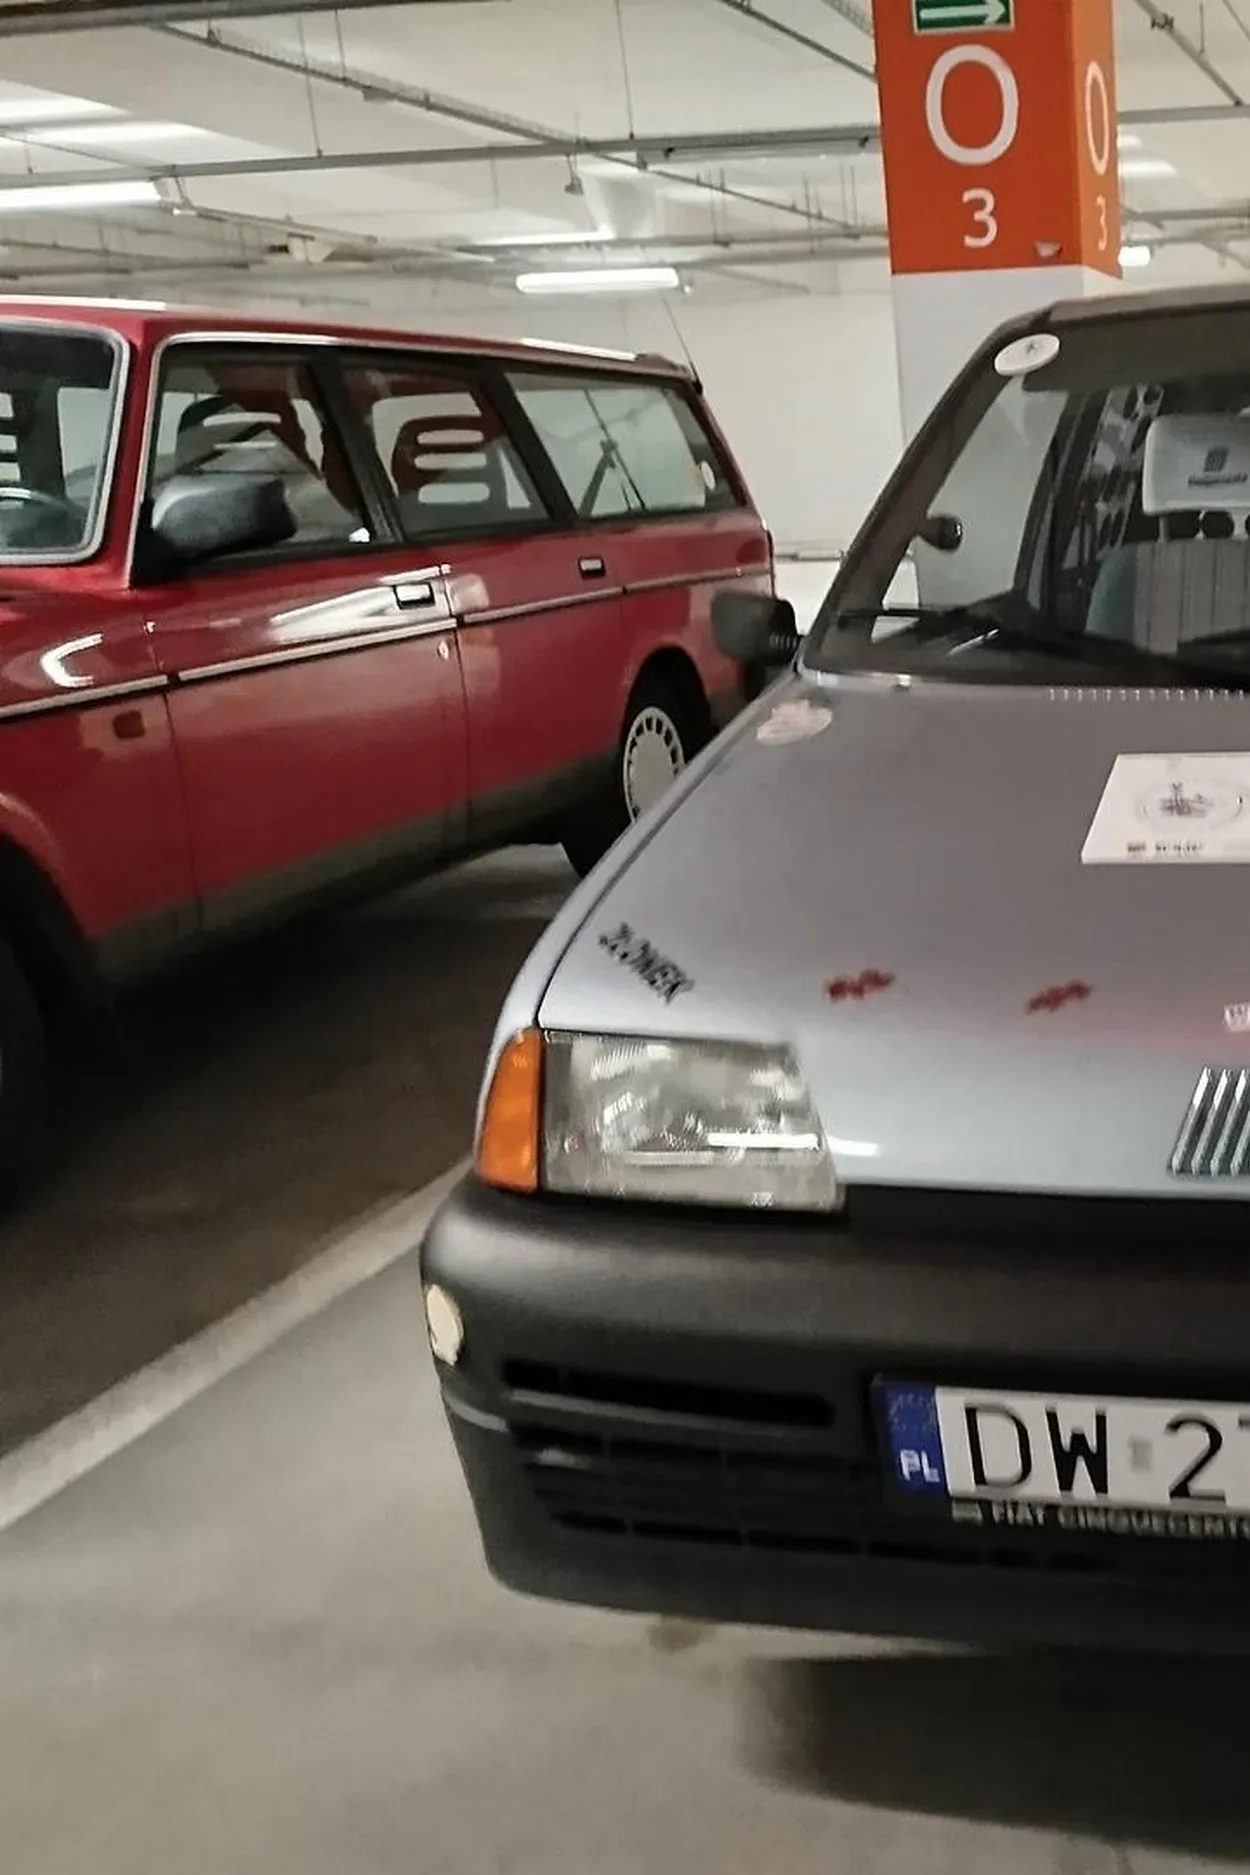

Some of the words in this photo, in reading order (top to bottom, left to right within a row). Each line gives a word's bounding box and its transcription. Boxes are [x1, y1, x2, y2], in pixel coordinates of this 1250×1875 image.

[962, 187, 998, 248] 3
[1097, 194, 1108, 251] 3
[900, 1449, 940, 1482] PL
[964, 1404, 1108, 1496] DW
